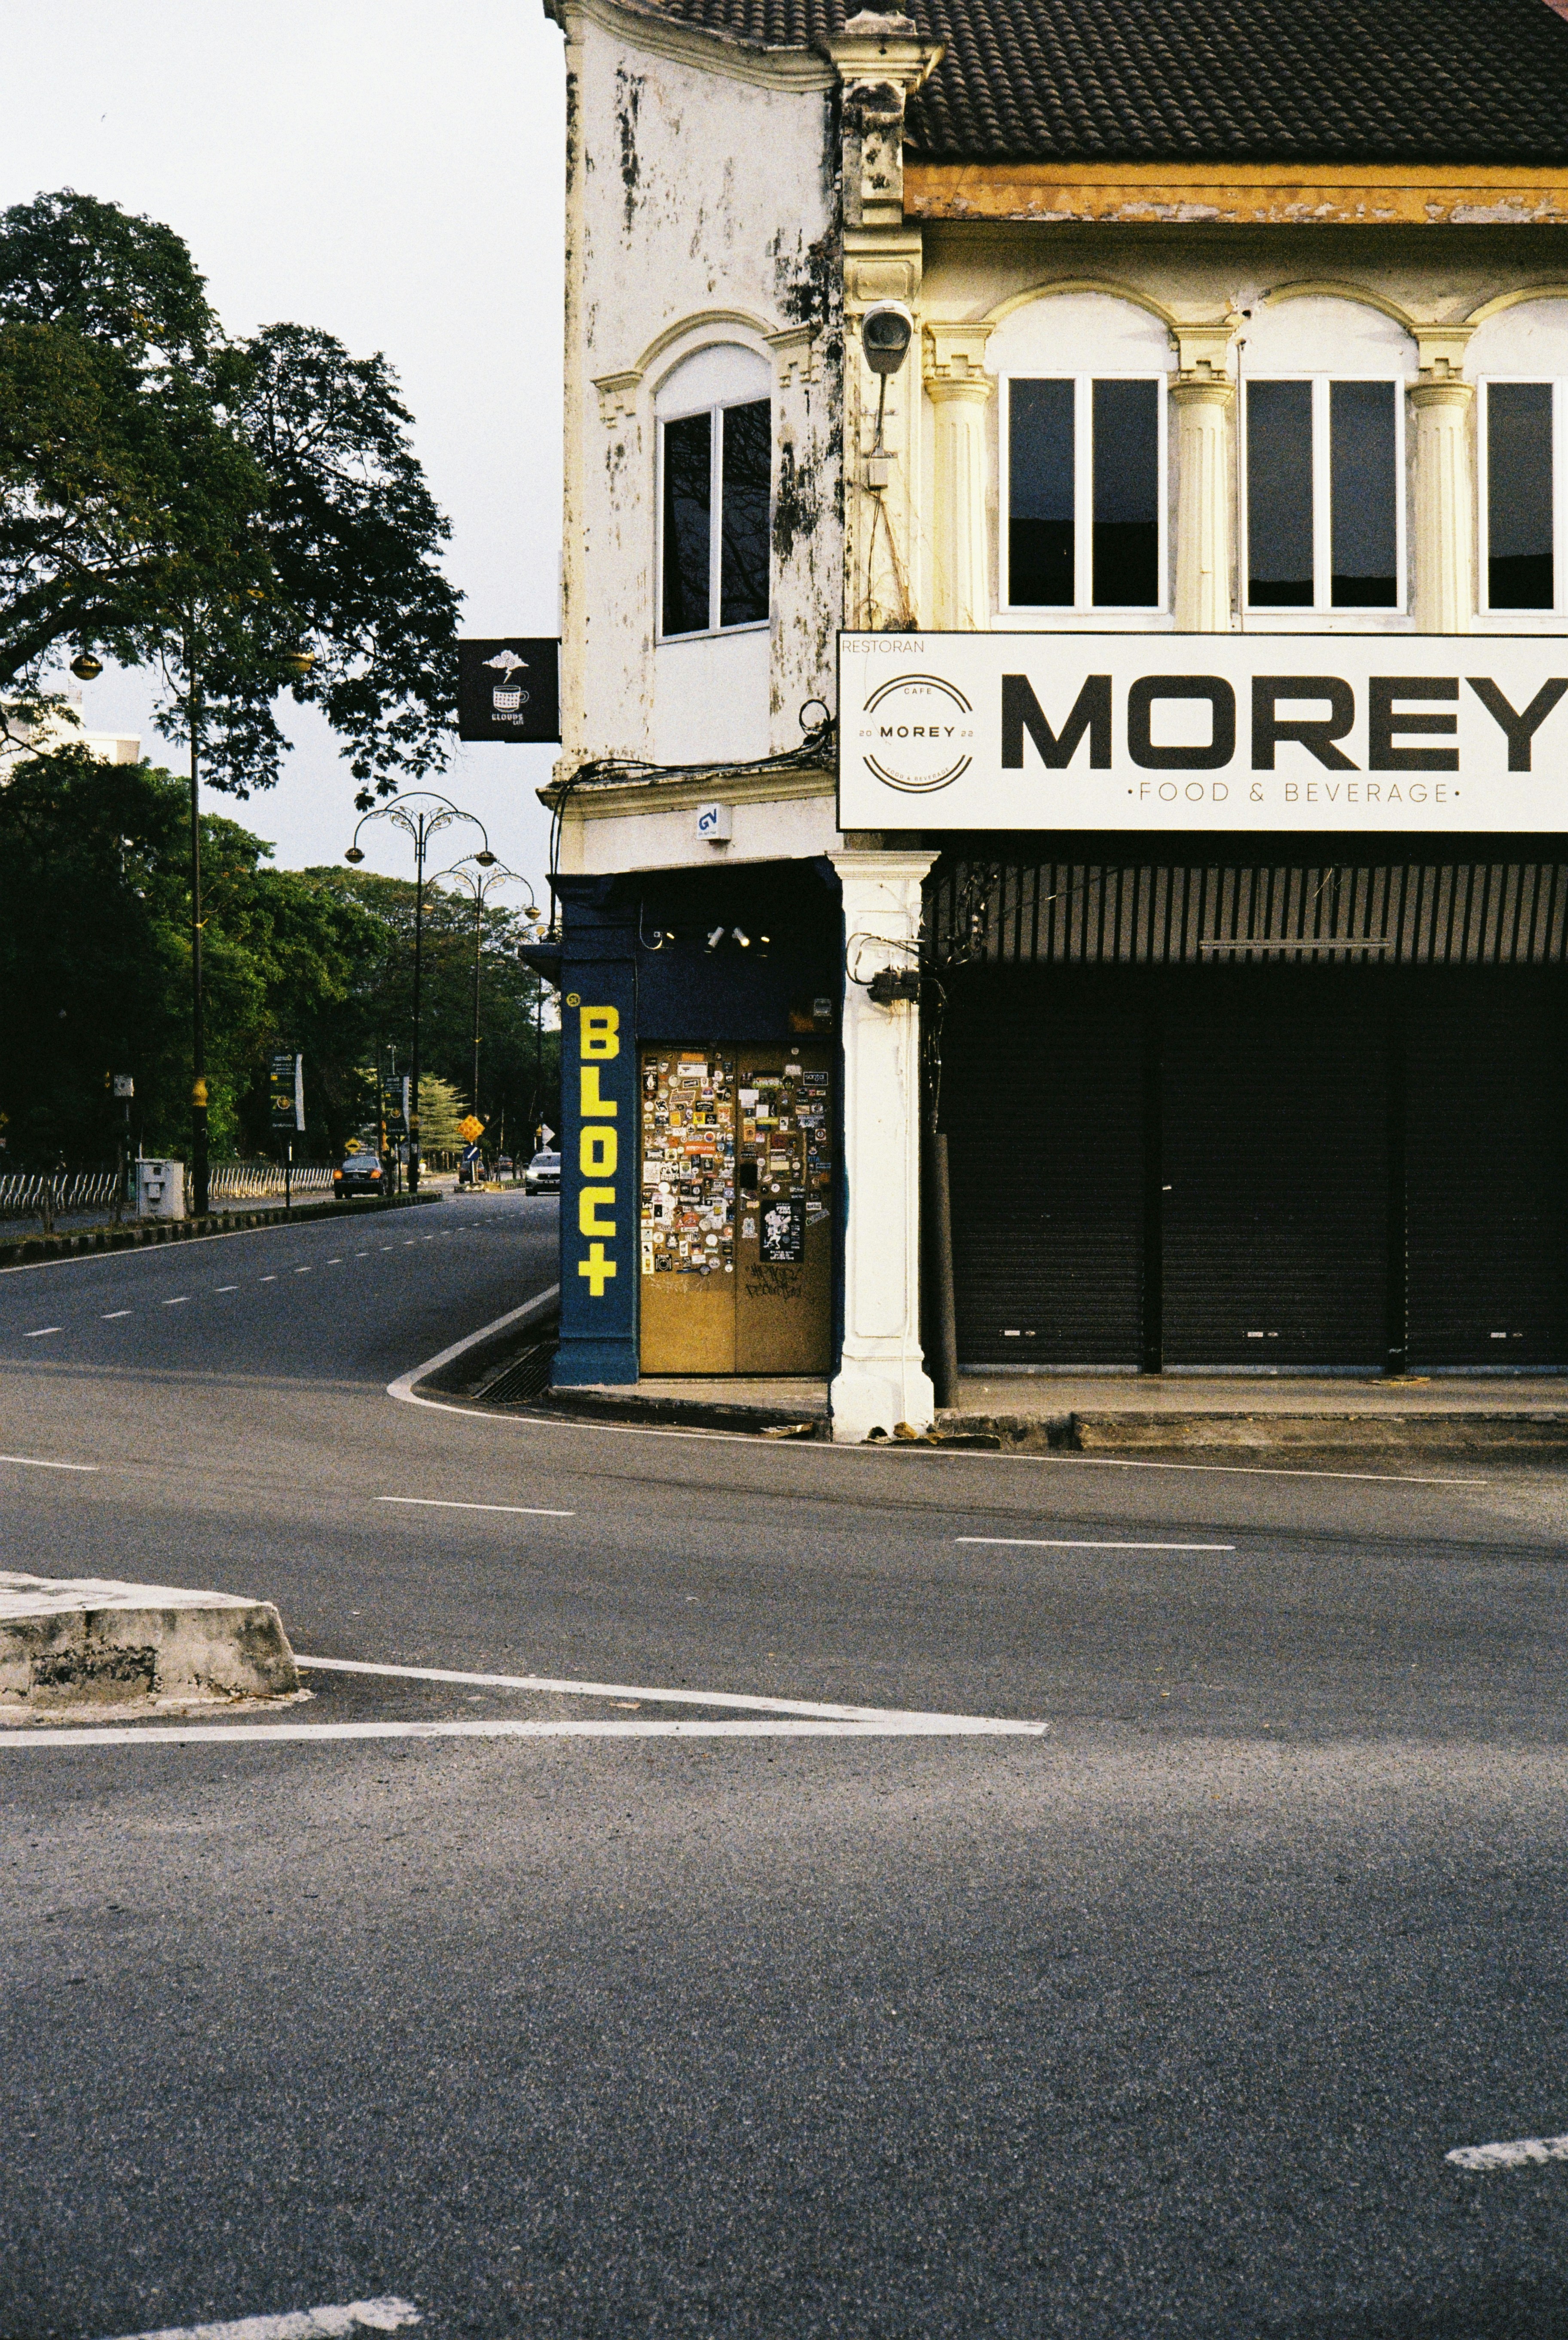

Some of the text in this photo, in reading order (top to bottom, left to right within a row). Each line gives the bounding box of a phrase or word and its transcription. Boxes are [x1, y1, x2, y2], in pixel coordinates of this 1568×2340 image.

[842, 640, 924, 653] RESTORAN
[1002, 674, 1568, 772] MOREY
[880, 726, 955, 738] MOREY
[886, 767, 904, 779] FOOD
[914, 767, 950, 781] BEVERAGE
[1140, 782, 1446, 802] FOOD & BEVERAGE
